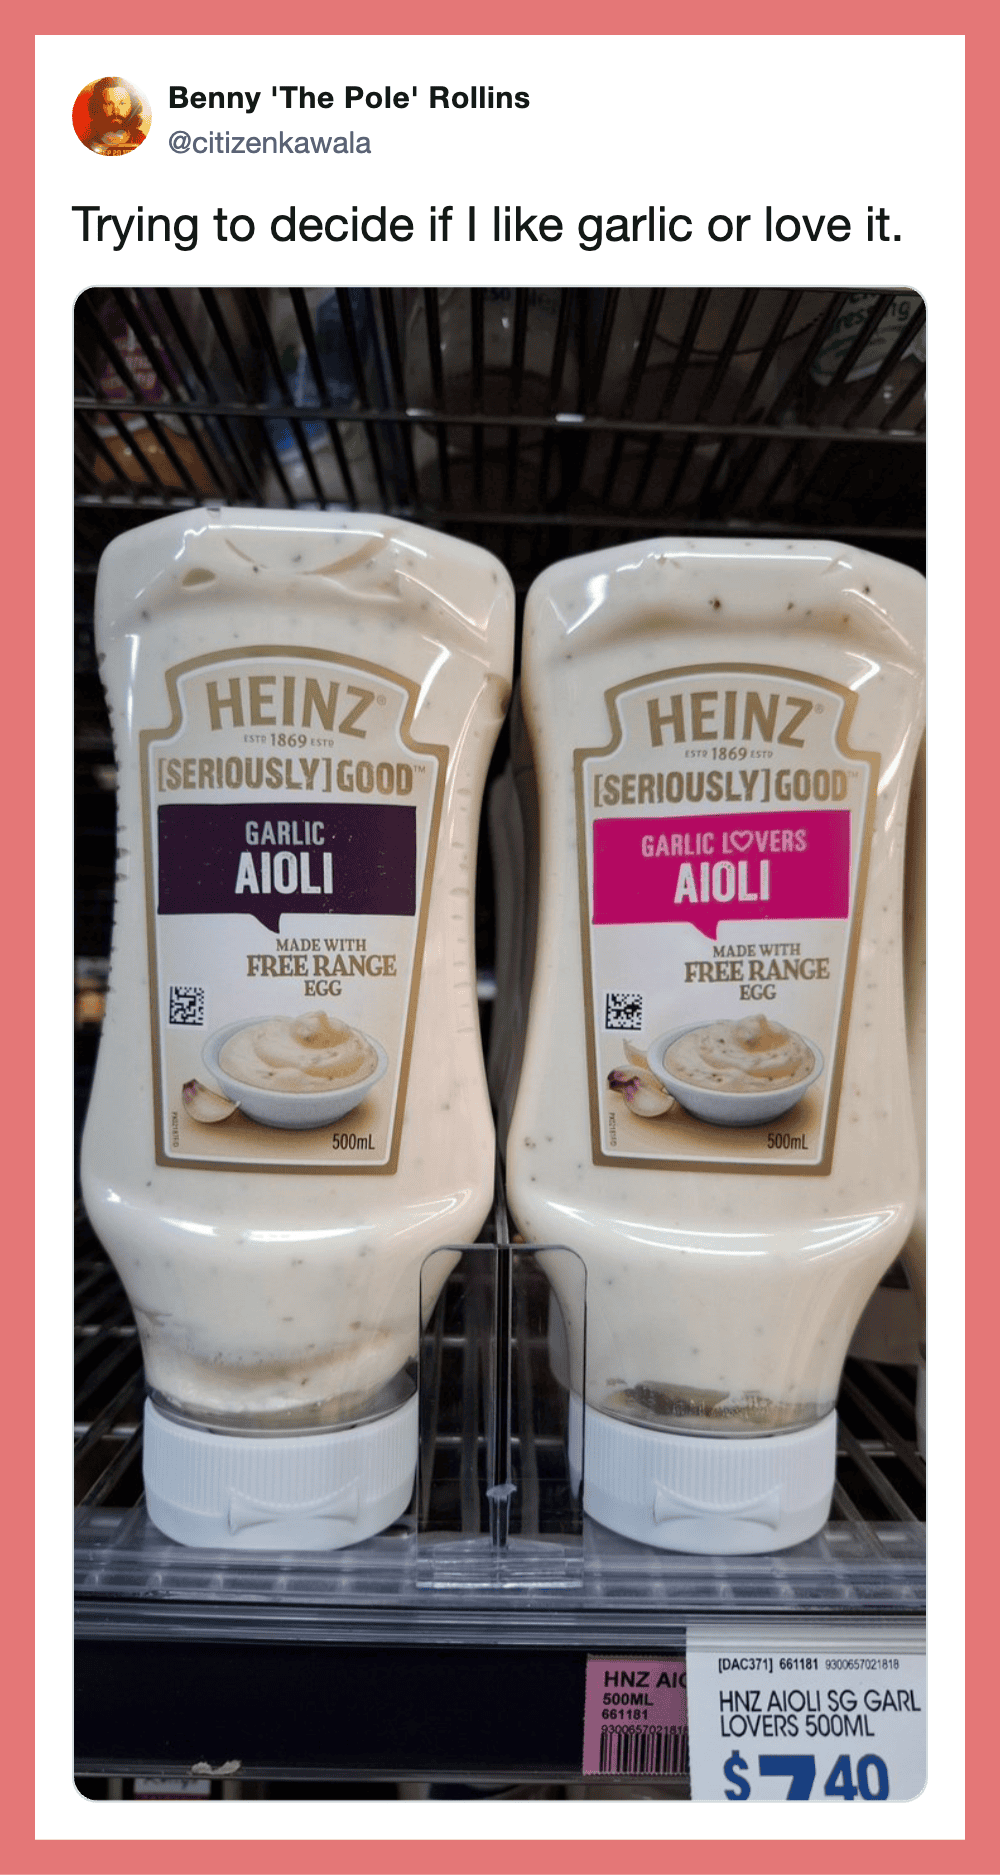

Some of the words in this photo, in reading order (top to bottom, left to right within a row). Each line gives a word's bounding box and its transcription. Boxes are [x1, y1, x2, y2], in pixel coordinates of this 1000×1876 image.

[205, 675, 376, 739] HEINZ
[646, 691, 814, 748] HEINZ
[270, 733, 307, 748] 1869
[711, 747, 747, 760] 1869
[245, 820, 325, 846] GARLIC
[641, 831, 714, 858] GARLIC
[234, 851, 334, 894] AIOLI
[673, 859, 771, 904] AIOLI
[276, 938, 321, 952] MADE
[324, 938, 367, 952] WITH
[712, 944, 756, 958] MADE
[758, 943, 801, 956] WITH
[246, 954, 309, 977] FREE
[312, 954, 397, 978] RANGE
[684, 960, 744, 983] FREE
[748, 958, 830, 982] RANGE
[304, 980, 342, 997] EGG
[739, 984, 776, 1001] EGG
[332, 1133, 376, 1150] 500mL
[767, 1133, 808, 1150] 500mL
[718, 1658, 774, 1674] [DAC371]
[779, 1658, 818, 1670] 661181
[825, 1659, 900, 1670] 9300657021818
[604, 1670, 650, 1688] HNZ
[602, 1692, 654, 1706] 500ML
[719, 1690, 763, 1712] HNZ
[767, 1690, 821, 1712] AIOLI
[828, 1690, 858, 1712] SG
[863, 1690, 922, 1712] GARL
[602, 1708, 648, 1720] 661181
[720, 1715, 799, 1737] LOVERS
[805, 1714, 875, 1737] 500ML
